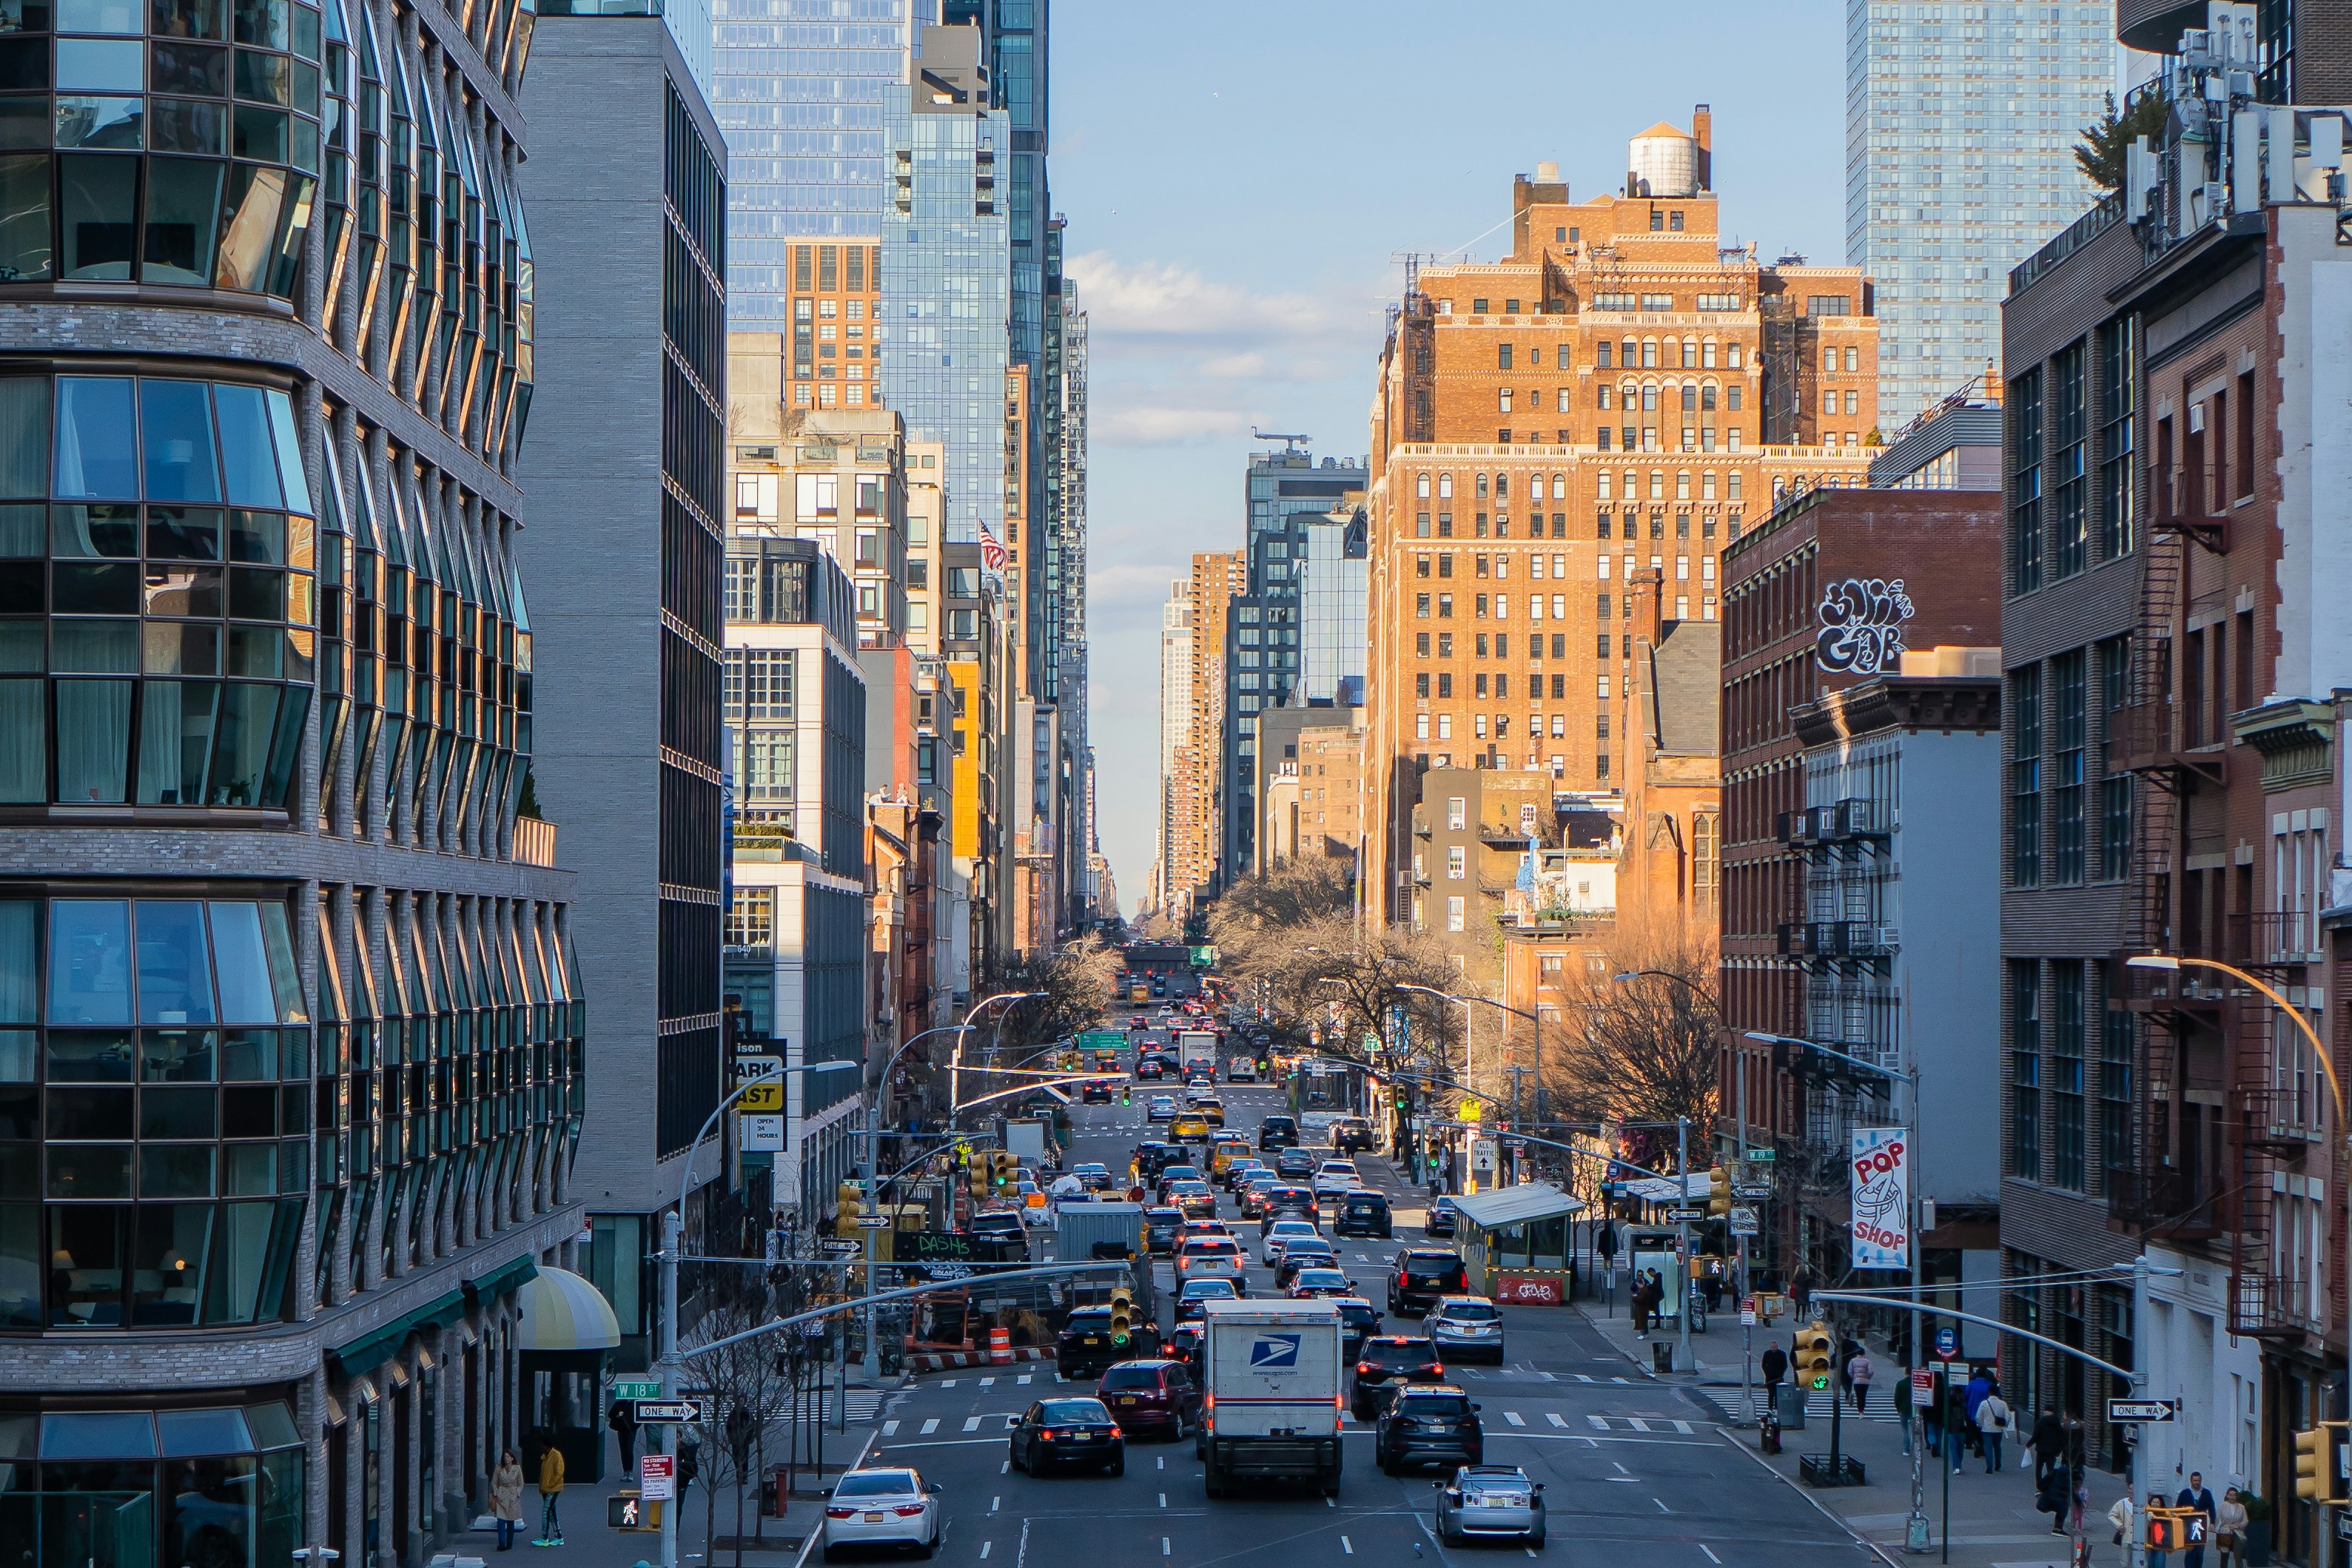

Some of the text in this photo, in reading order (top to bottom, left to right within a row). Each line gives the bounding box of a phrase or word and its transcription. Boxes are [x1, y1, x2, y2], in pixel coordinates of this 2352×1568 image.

[737, 944, 750, 953] 640
[736, 1063, 776, 1078] ARK
[736, 1088, 775, 1103] AST
[1749, 1151, 1755, 1160] W
[1854, 1138, 1894, 1160] Reviving the
[1854, 1143, 1904, 1185] POP
[1854, 1221, 1906, 1251] SHOP
[619, 1384, 628, 1397] W
[635, 1384, 646, 1397] 18
[645, 1407, 692, 1416] ONE WAY
[2118, 1407, 2165, 1415] ONE WAY
